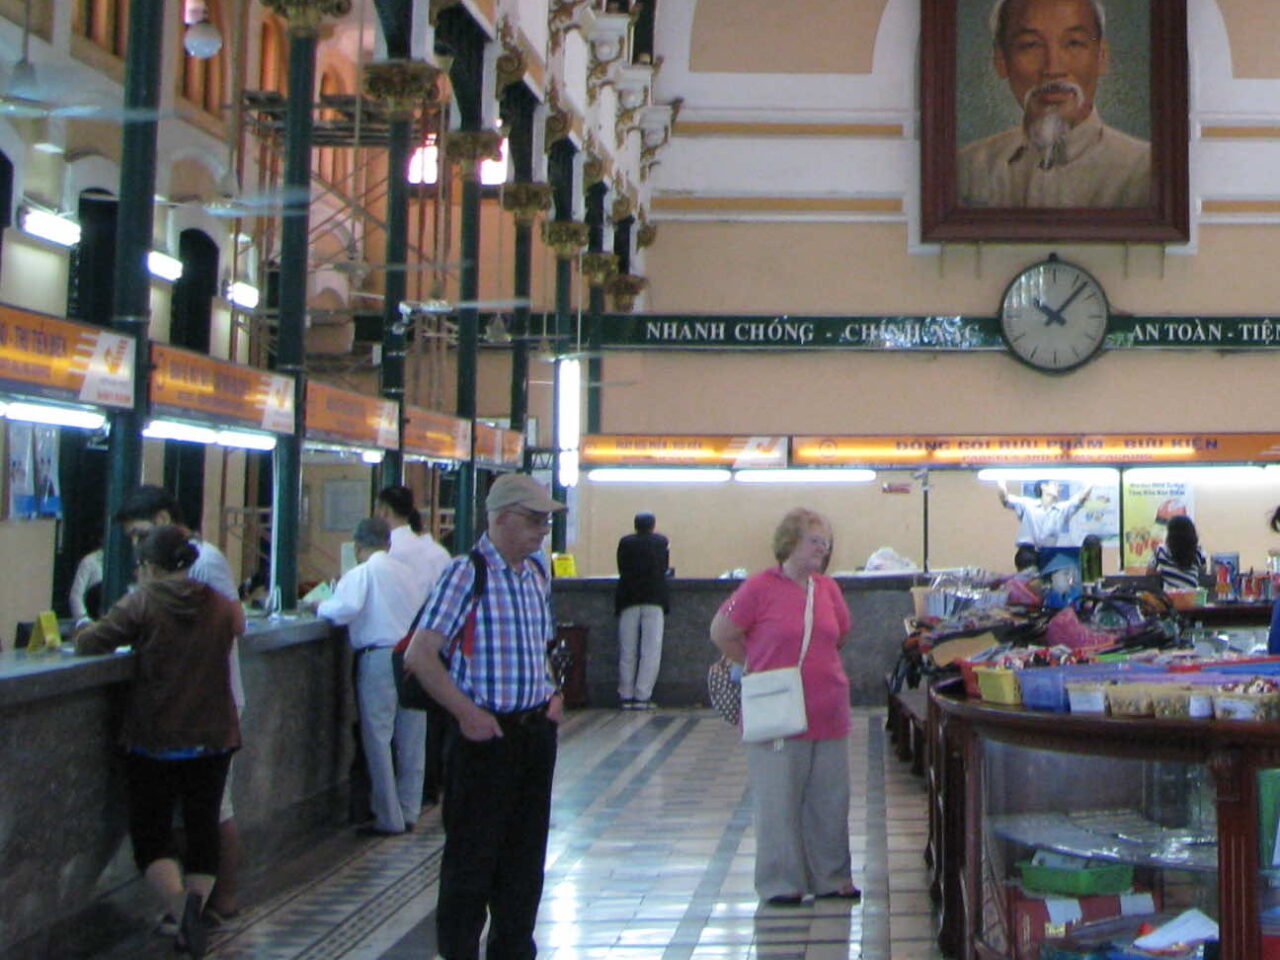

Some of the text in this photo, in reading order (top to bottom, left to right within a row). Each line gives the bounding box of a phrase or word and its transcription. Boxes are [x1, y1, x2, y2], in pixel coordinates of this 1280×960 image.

[647, 322, 726, 340] NHANH
[734, 318, 814, 341] CHÓNG
[1132, 324, 1159, 341] AN
[1164, 318, 1222, 341] TOÀN
